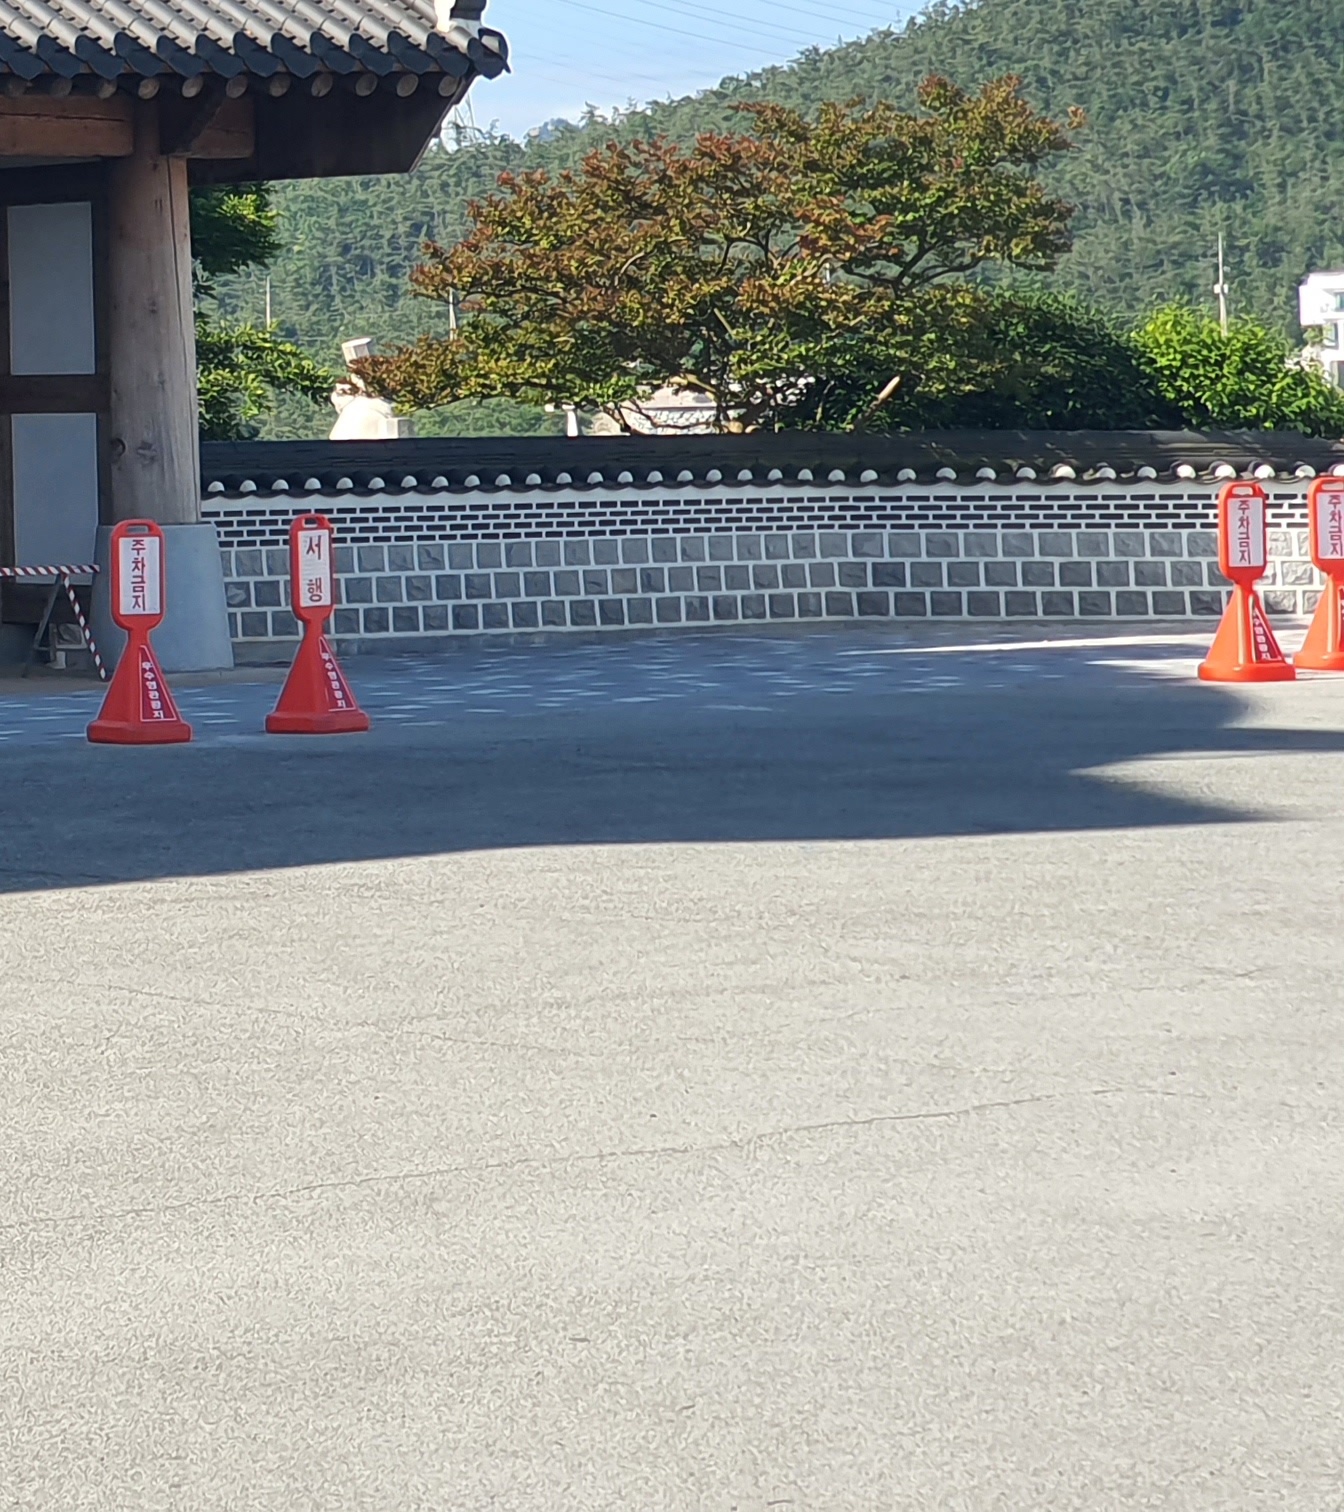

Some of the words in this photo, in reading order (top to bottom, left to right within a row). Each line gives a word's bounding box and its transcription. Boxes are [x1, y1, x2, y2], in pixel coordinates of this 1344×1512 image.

[1237, 500, 1251, 565] 주차금지
[1328, 494, 1344, 556] 주차금지
[131, 539, 146, 611] 주차금지
